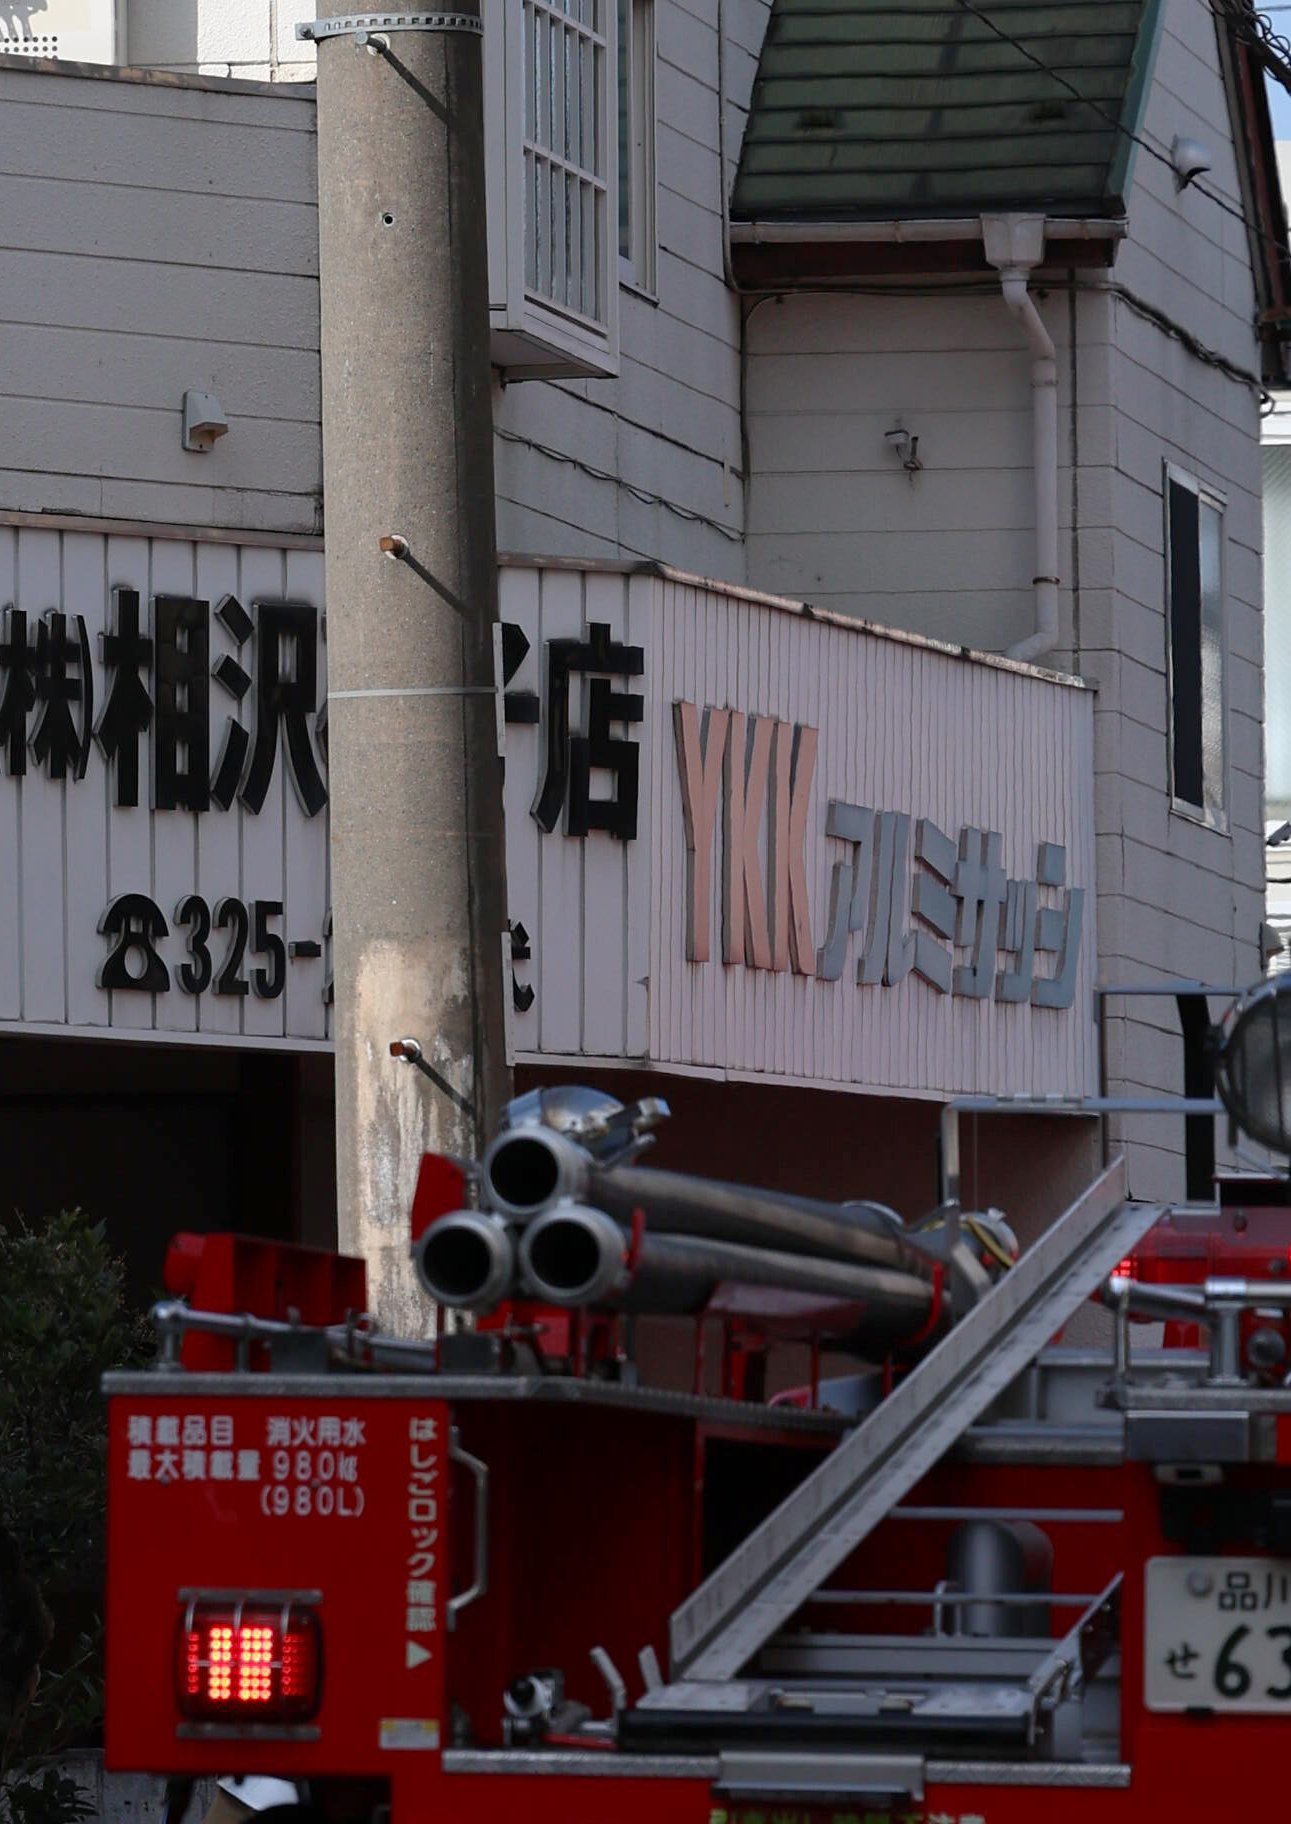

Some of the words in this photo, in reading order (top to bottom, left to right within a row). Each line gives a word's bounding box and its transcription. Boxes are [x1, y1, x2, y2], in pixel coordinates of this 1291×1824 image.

[672, 700, 819, 977] YKK
[817, 798, 1086, 1010] アルミサッシ
[127, 1415, 234, 1447] 積載品目
[266, 1415, 366, 1447] 消火用水
[127, 1449, 261, 1480] 最大積載量
[260, 1485, 365, 1517] (980L)
[1164, 1641, 1200, 1680] せ
[1213, 1623, 1291, 1700] 63
